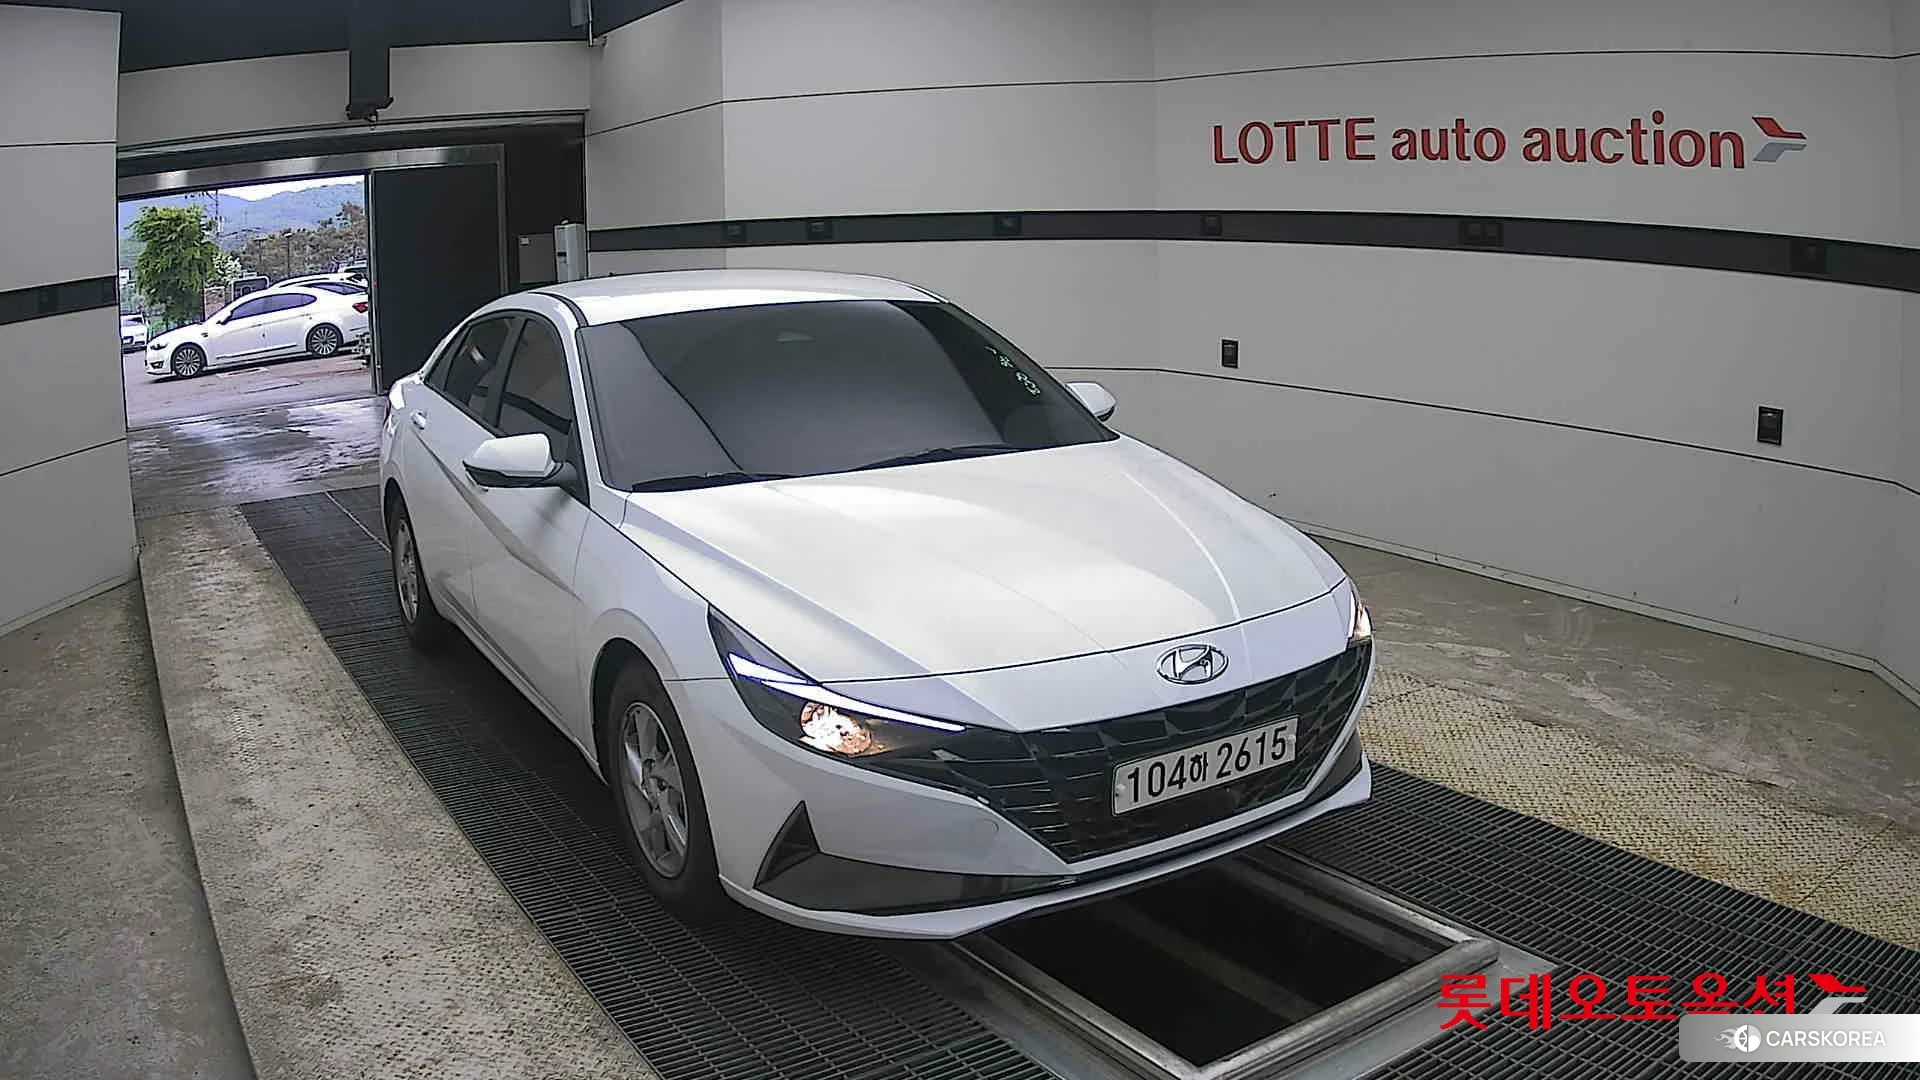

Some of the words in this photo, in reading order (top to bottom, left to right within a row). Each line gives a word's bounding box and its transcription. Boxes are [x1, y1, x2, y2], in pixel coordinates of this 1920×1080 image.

[1213, 117, 1376, 165] LOTTE
[1391, 118, 1507, 161] auto
[1522, 110, 1745, 169] auction
[1127, 751, 1208, 803] 104하
[1216, 725, 1288, 780] 2615
